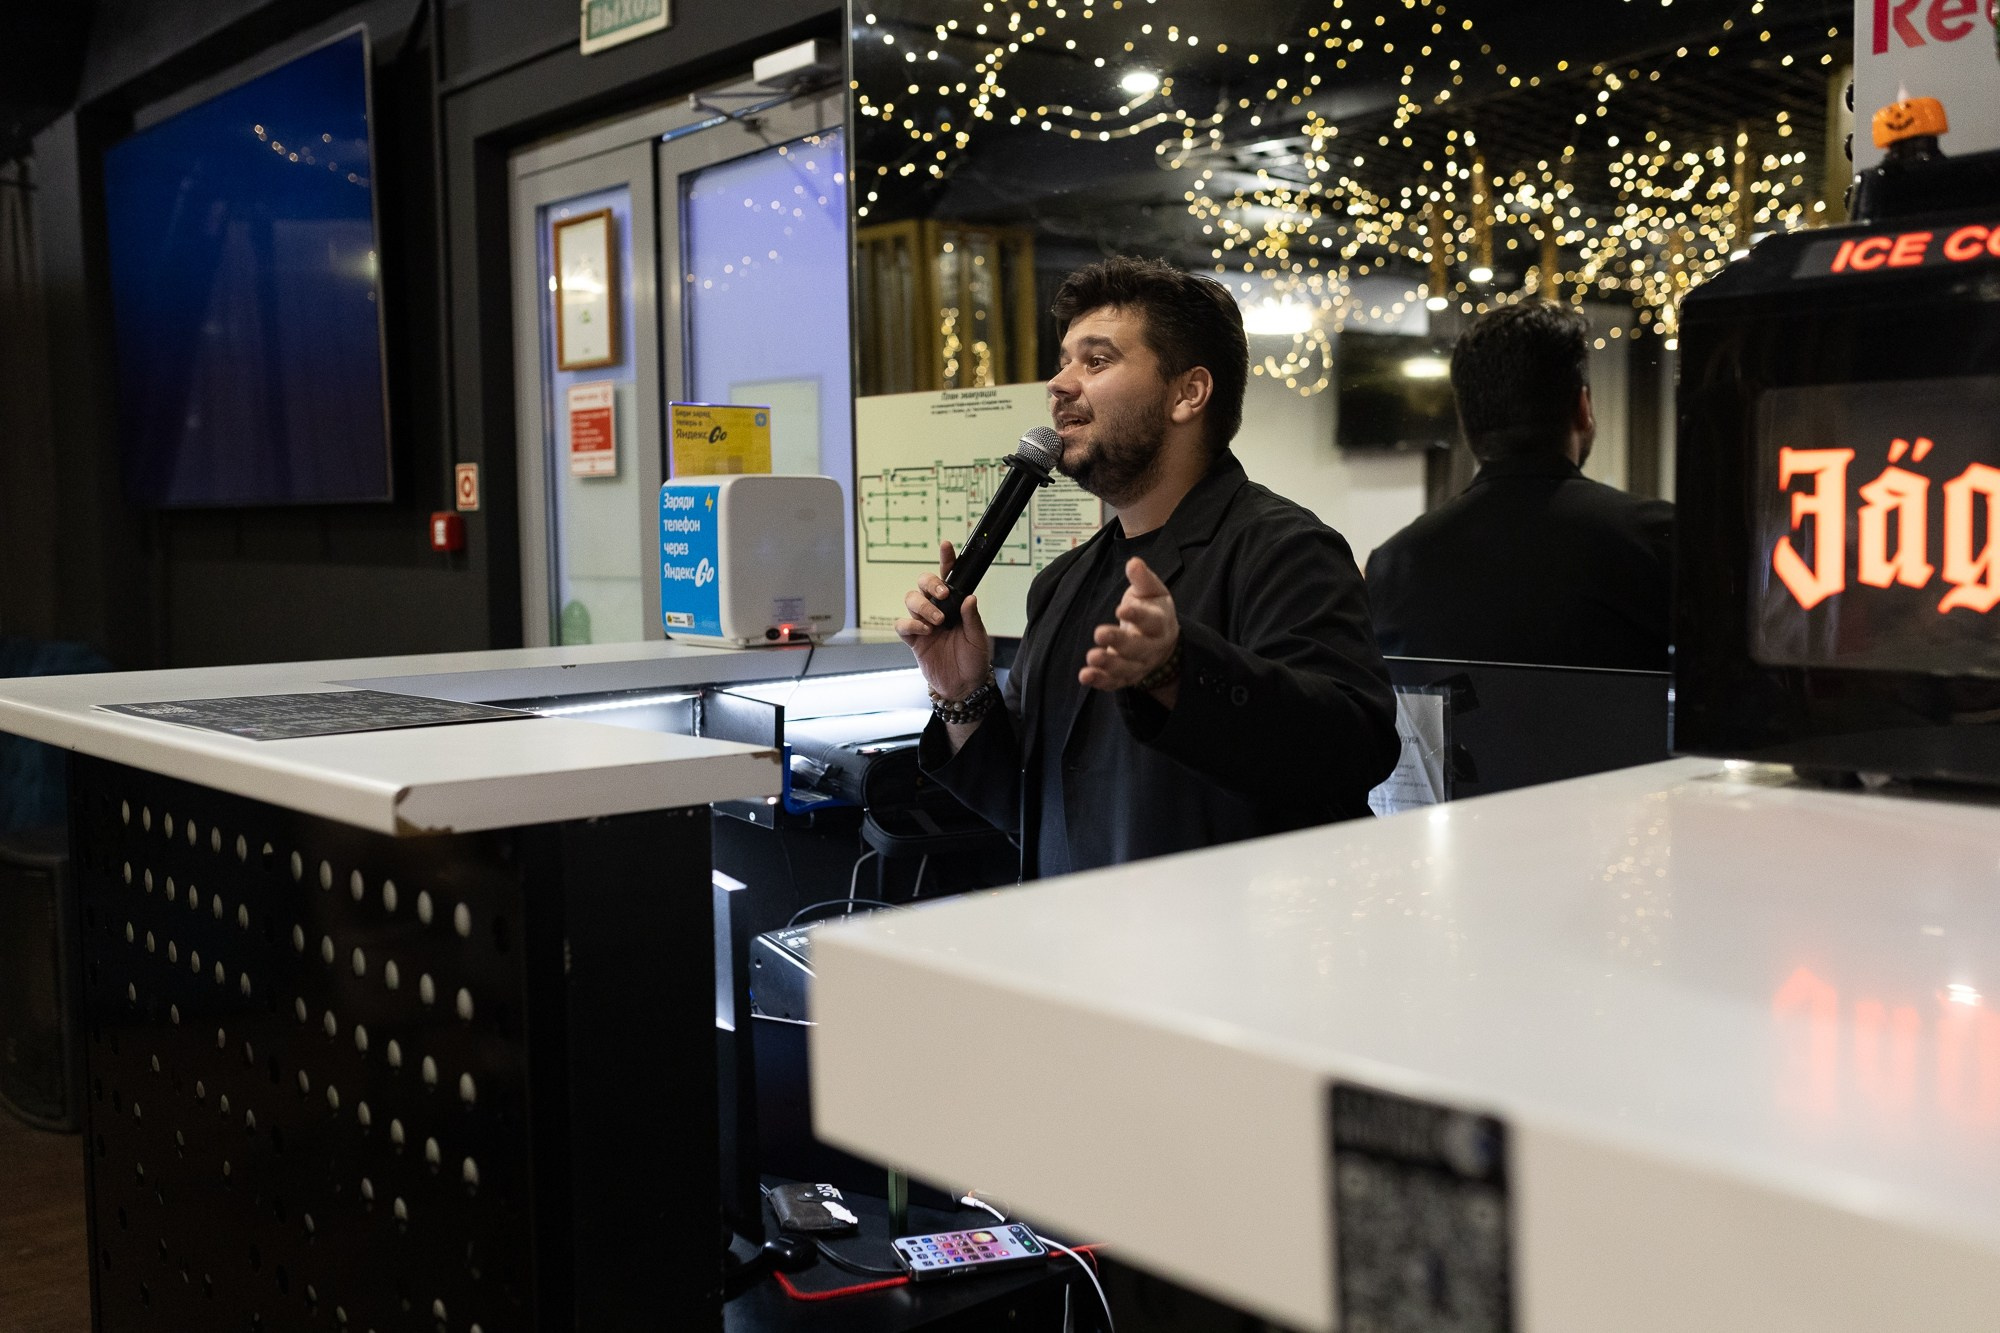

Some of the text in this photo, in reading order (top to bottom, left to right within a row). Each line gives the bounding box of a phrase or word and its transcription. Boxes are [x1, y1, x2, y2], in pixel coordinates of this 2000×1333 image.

[1872, 0, 1997, 55] Re
[1831, 231, 1933, 273] ICE
[676, 426, 728, 444] Яндекс Go
[663, 492, 695, 511] Заряди
[663, 515, 701, 535] телефон
[663, 542, 689, 557] через
[663, 558, 715, 588] Яндекс Go
